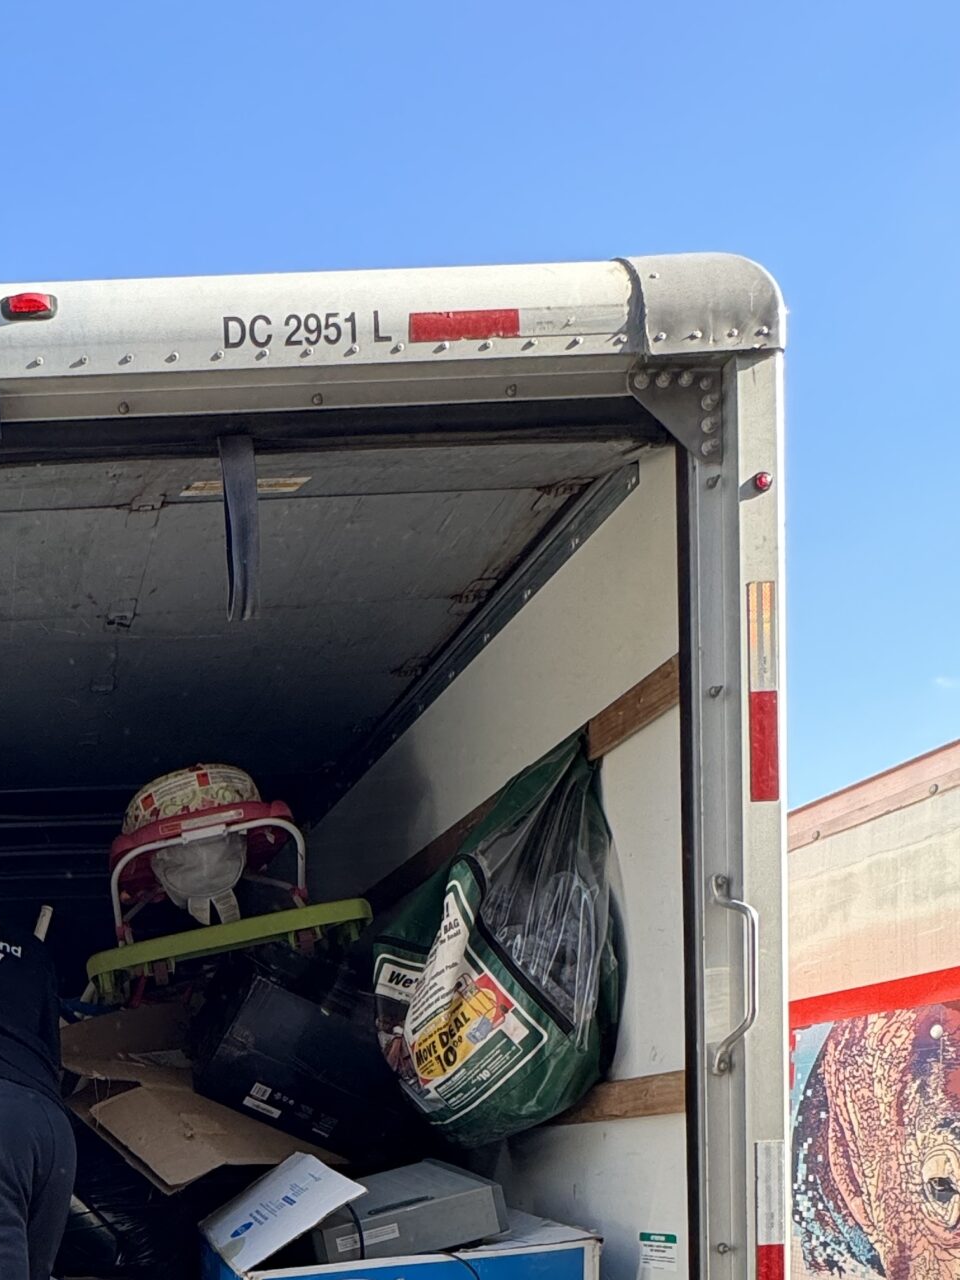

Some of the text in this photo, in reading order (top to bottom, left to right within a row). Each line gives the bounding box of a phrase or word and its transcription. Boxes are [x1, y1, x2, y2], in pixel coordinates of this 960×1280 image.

[223, 310, 392, 349] DC 2951 L
[443, 919, 460, 934] BAG
[415, 1041, 437, 1068] MOVE
[438, 1011, 470, 1049] DEAL
